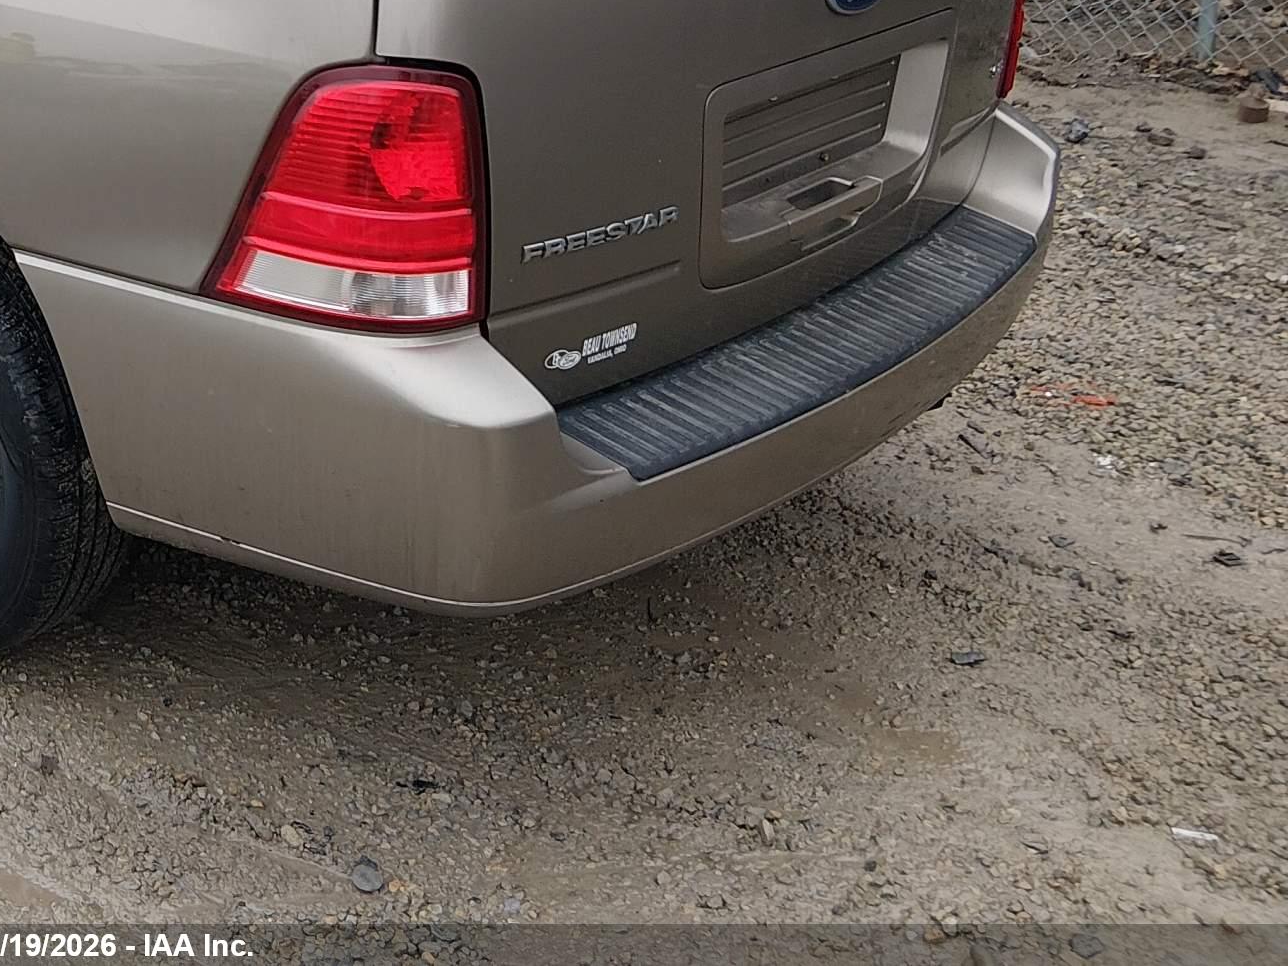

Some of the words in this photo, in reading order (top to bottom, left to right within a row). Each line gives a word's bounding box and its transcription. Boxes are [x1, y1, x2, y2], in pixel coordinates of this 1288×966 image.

[521, 205, 680, 264] FREESTAR
[582, 335, 602, 357] BEAU
[601, 322, 637, 350] TOWNSEND
